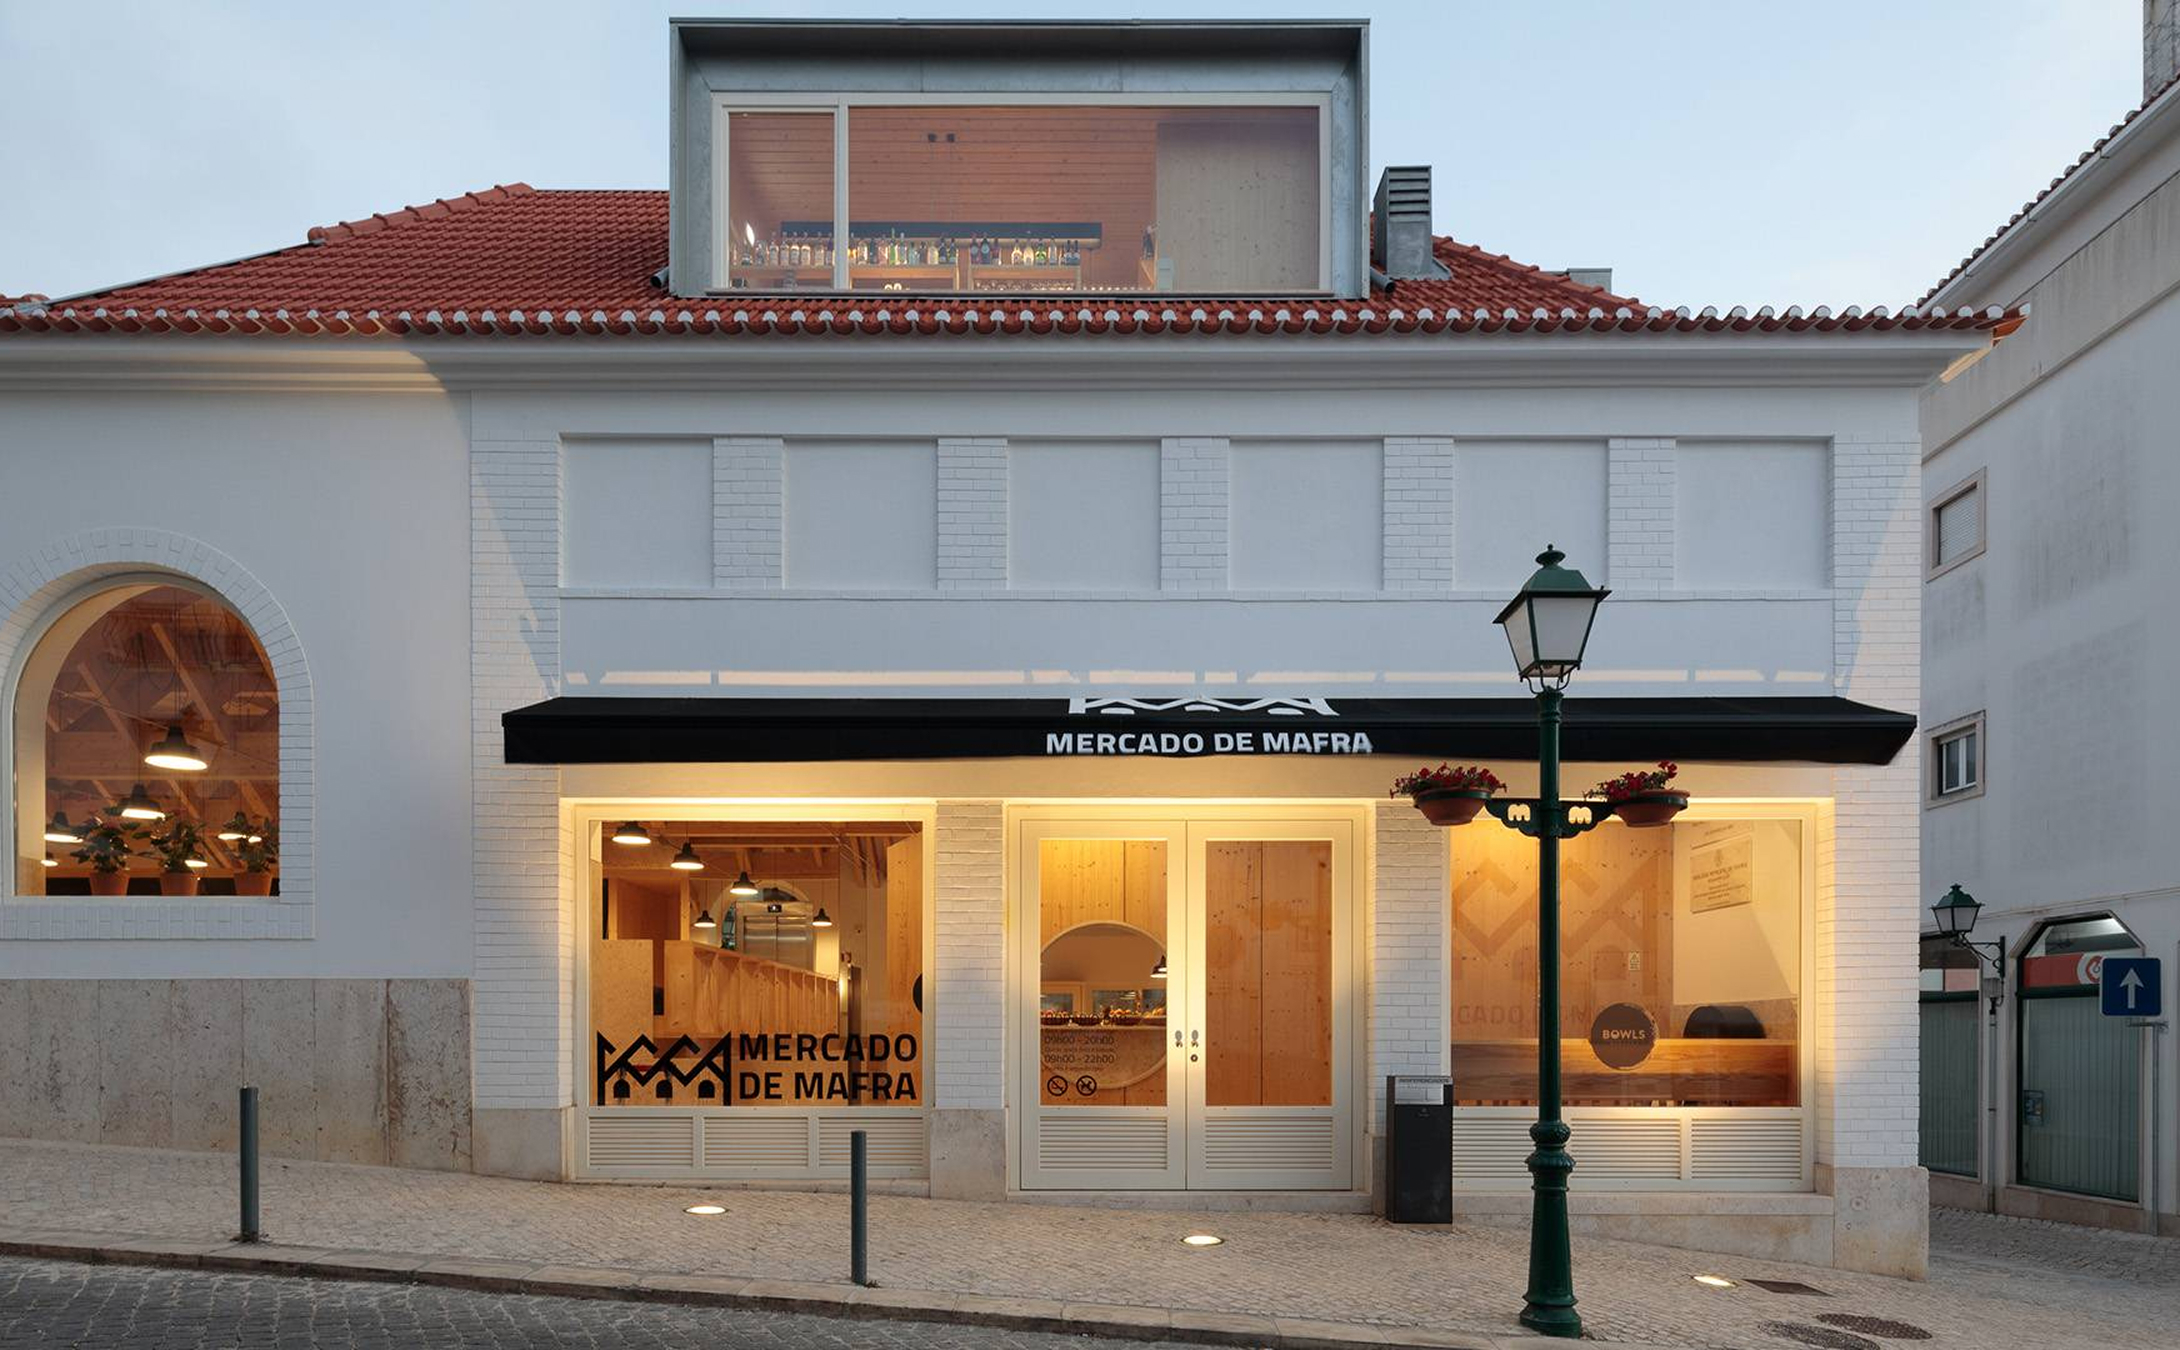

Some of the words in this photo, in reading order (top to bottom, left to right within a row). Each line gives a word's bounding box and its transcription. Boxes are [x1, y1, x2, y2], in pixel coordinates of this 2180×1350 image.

[1046, 732, 1204, 754] MERCADO
[1213, 732, 1255, 752] DE
[1262, 731, 1374, 753] MAFRA
[1602, 1029, 1646, 1040] BOWLS
[739, 1033, 917, 1062] MERCADO
[1084, 1054, 1115, 1063] 22h00
[739, 1071, 783, 1100] DE
[795, 1071, 917, 1100] MAFRA
